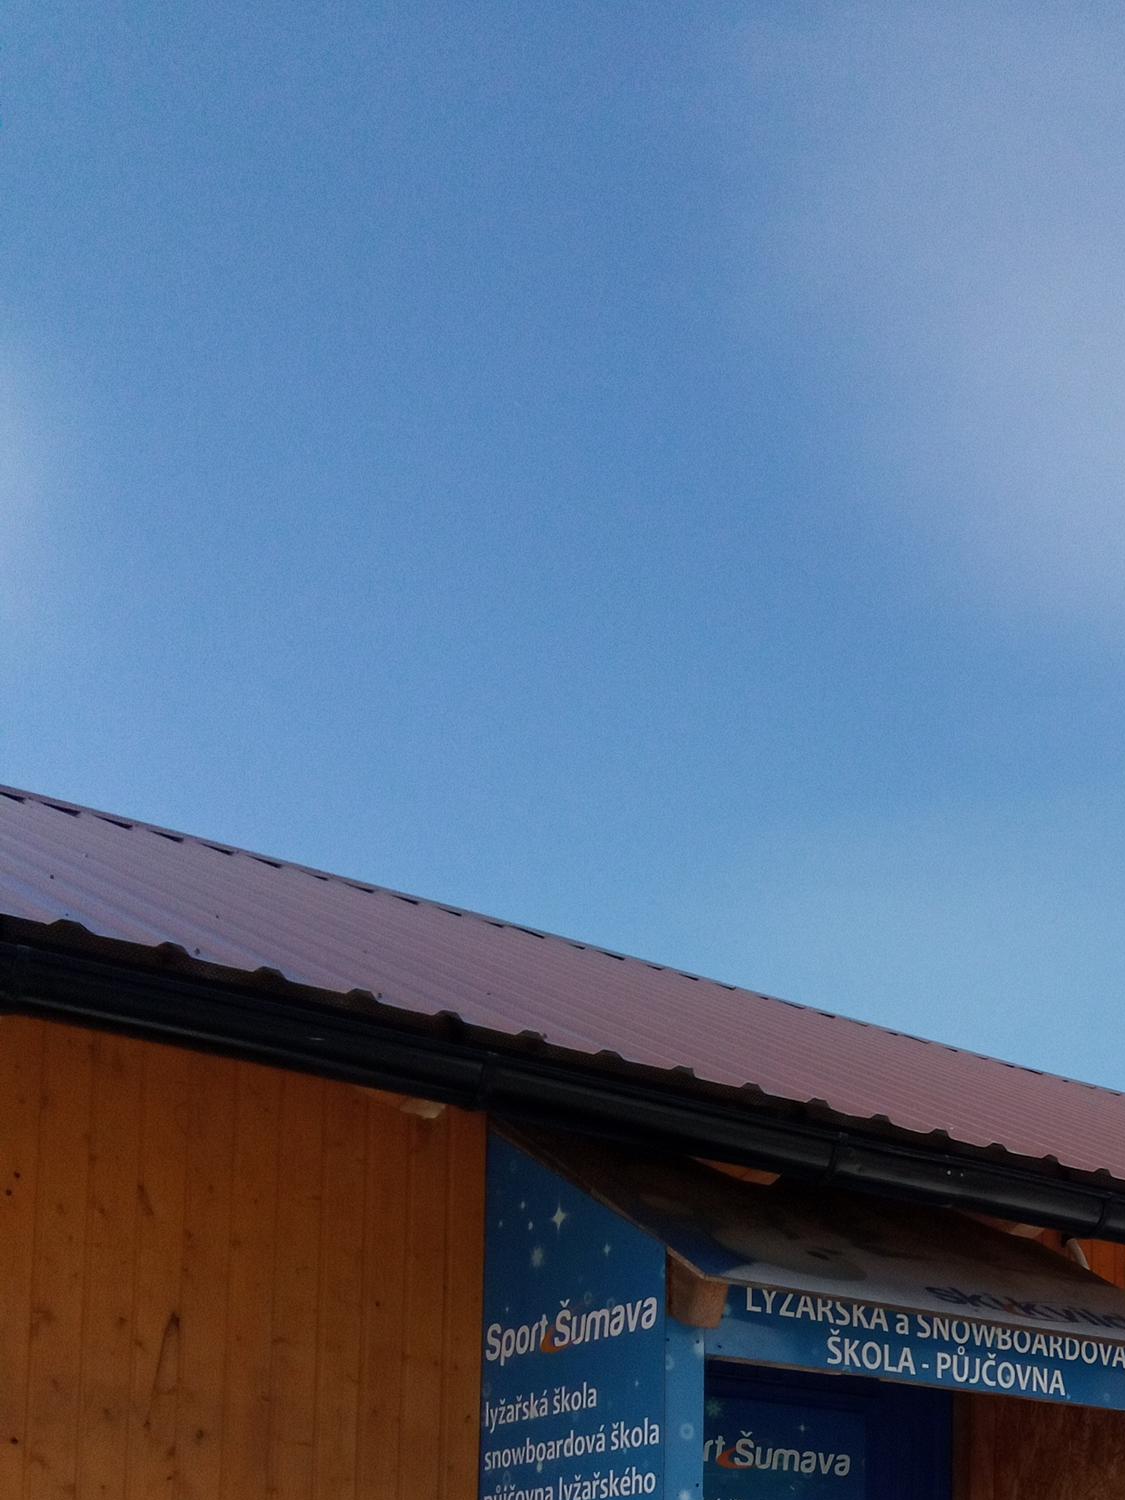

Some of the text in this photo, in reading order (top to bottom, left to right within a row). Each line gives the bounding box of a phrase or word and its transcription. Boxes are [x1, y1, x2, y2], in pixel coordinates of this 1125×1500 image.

[485, 1297, 658, 1366] Sport Šumava
[895, 1313, 910, 1336] a
[826, 1329, 917, 1376] ŠKOLA
[937, 1345, 1067, 1396] PŮJČOVNA
[485, 1381, 598, 1433] lyžařská škola
[484, 1417, 660, 1471] snowboardová škola
[733, 1431, 851, 1477] Šumava
